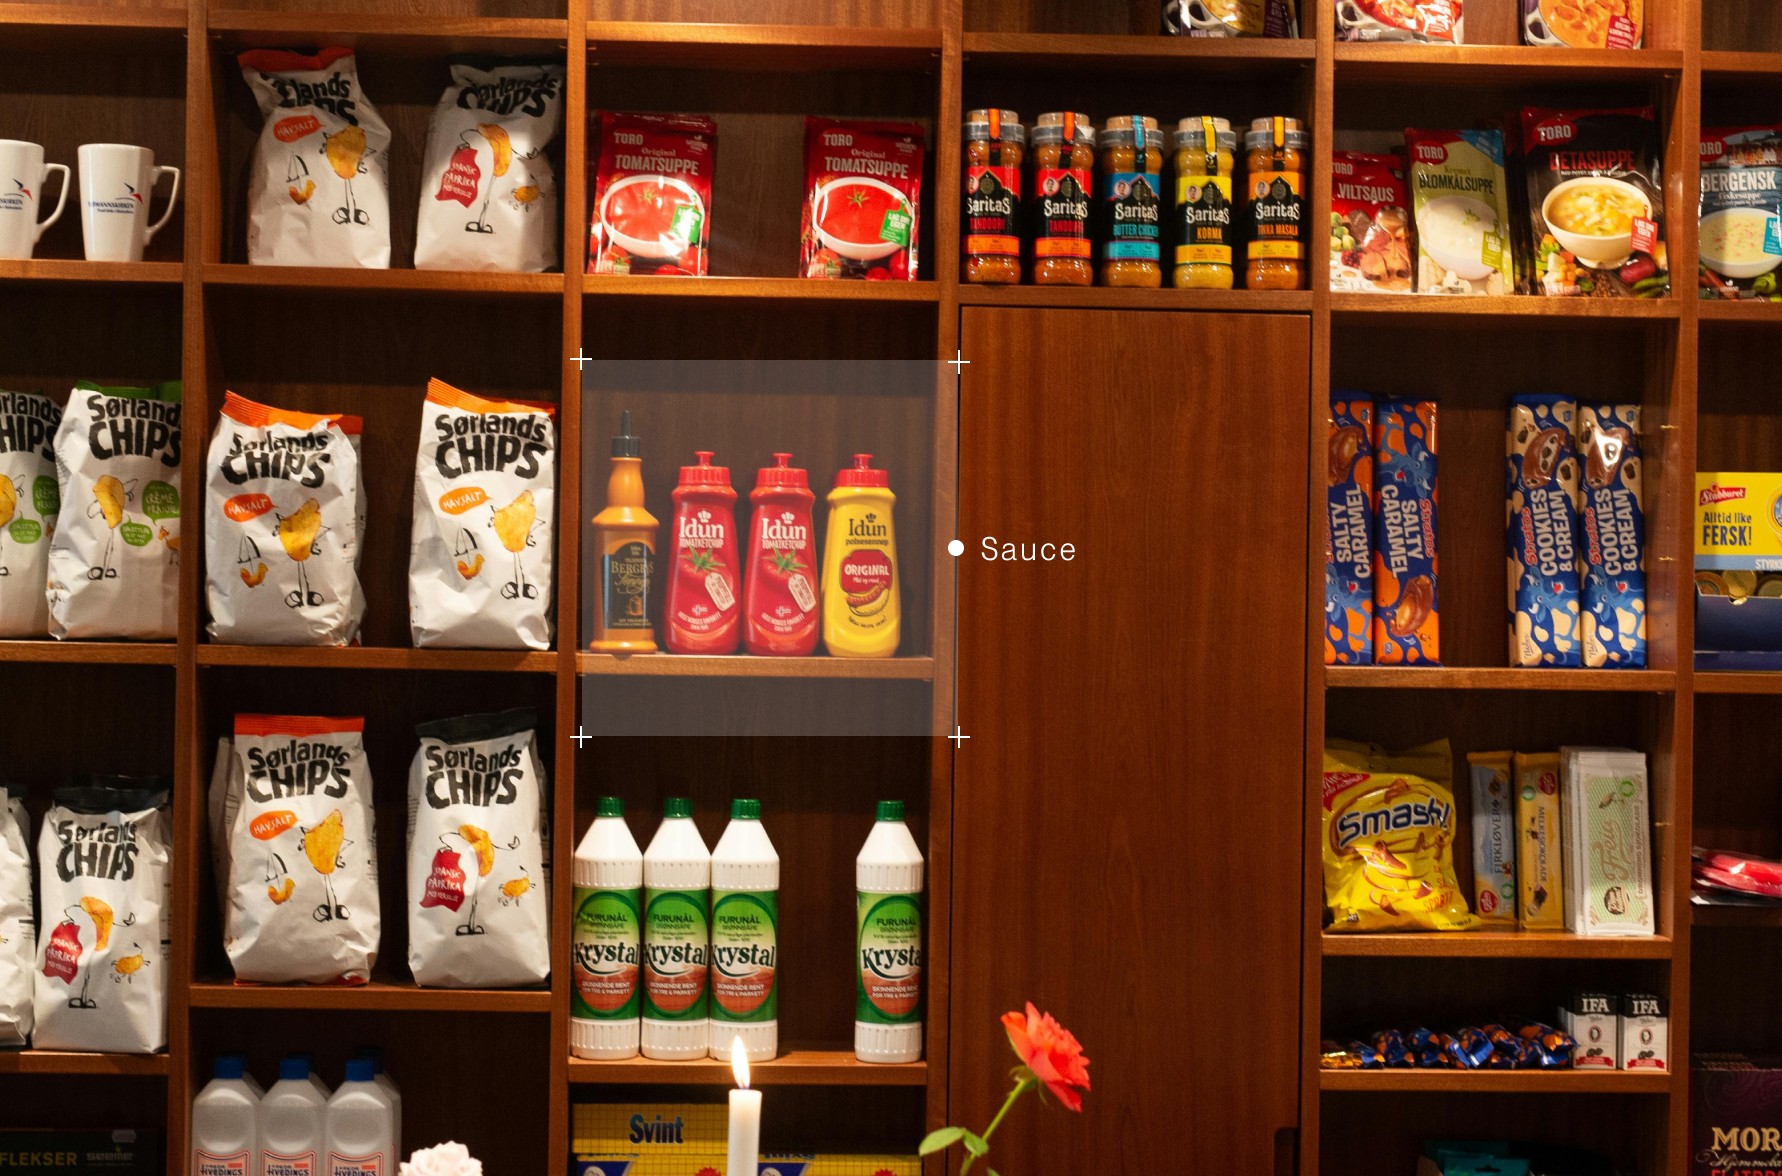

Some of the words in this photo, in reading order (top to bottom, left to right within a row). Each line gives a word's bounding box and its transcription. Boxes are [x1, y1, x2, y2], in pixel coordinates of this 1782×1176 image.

[614, 132, 644, 146] TORO
[823, 134, 853, 146] TORO
[1537, 124, 1572, 142] TORO
[641, 147, 676, 157] Original
[851, 148, 886, 159] Original
[1416, 145, 1445, 160] TORO
[1549, 149, 1635, 171] BETASUPPE
[615, 154, 699, 176] TOMATSUPPE
[824, 156, 909, 179] TOMATSUPPE
[1418, 172, 1494, 194] BLOMKÅLSUPPE
[1702, 170, 1777, 192] BERGENSK
[1338, 182, 1395, 203] VILTSAUS
[1196, 226, 1223, 240] KORMA
[435, 413, 547, 442] Sørlands
[89, 418, 181, 468] CHIPS
[435, 433, 548, 479] CHIPS
[220, 450, 332, 489] CHIPS
[227, 499, 268, 515] HAVSALT
[442, 491, 482, 509] HAVSALT
[1701, 488, 1744, 504] Stabburet
[679, 515, 724, 538] Idun
[761, 517, 807, 540] Idun
[848, 518, 887, 537] Idun
[1419, 497, 1435, 559] Stratos
[1548, 489, 1573, 560] CREAM
[1612, 488, 1638, 560] CREAM
[1704, 511, 1732, 524] Alltid
[1734, 511, 1752, 524] like
[1330, 502, 1352, 563] SALTY
[1346, 484, 1371, 579] CARAMEL
[1381, 484, 1408, 579] CARAMEL
[1400, 499, 1424, 560] SALTY
[1520, 505, 1539, 566] Stratos
[1530, 488, 1558, 576] COOKIES
[1584, 505, 1603, 566] Stratos
[1594, 487, 1622, 576] COOKIES
[1703, 525, 1752, 546] FERSK!
[844, 563, 890, 577] ORIGINAL
[1559, 560, 1573, 573] &
[1622, 559, 1638, 573] &
[247, 739, 351, 770] Sørlands
[425, 743, 523, 772] Sørlands
[246, 759, 351, 803] CHIPS
[425, 768, 524, 810] CHIPS
[253, 814, 292, 835] HAVSALT
[1338, 797, 1453, 849] Smash!
[56, 841, 139, 882] CHIPS
[427, 877, 462, 892] PAPRIKA
[587, 912, 628, 922] FURUNÅL
[653, 912, 694, 922] FURUNÅL
[719, 914, 761, 924] FURUNÅL
[575, 941, 639, 974] Krystal
[644, 942, 708, 975] Krystal
[711, 944, 775, 977] Krystal
[1581, 998, 1610, 1013] IFA
[1632, 1000, 1661, 1015] IFA
[628, 1113, 684, 1144] Svint
